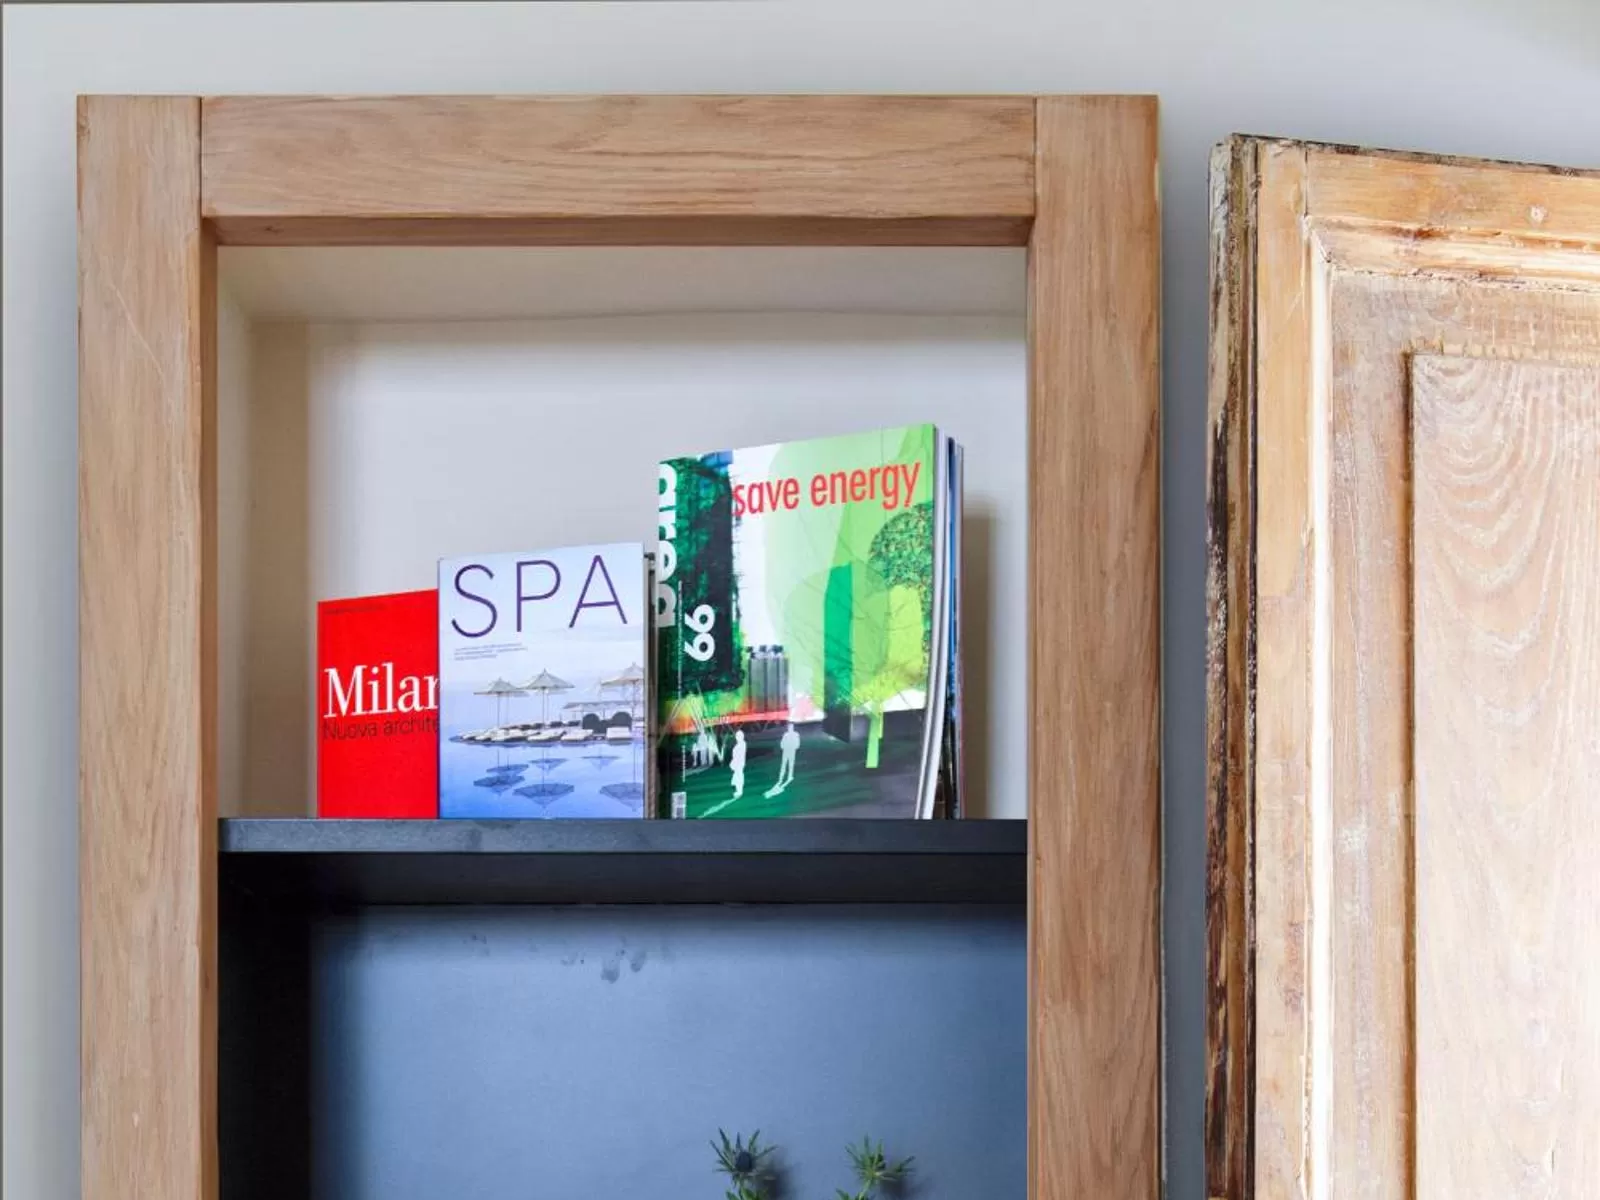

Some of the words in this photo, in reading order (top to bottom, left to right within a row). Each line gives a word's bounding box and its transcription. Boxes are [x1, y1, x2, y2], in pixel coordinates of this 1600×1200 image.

[732, 477, 801, 517] save
[810, 461, 922, 510] energy
[451, 554, 628, 639] SPA
[323, 719, 378, 741] Nuova
